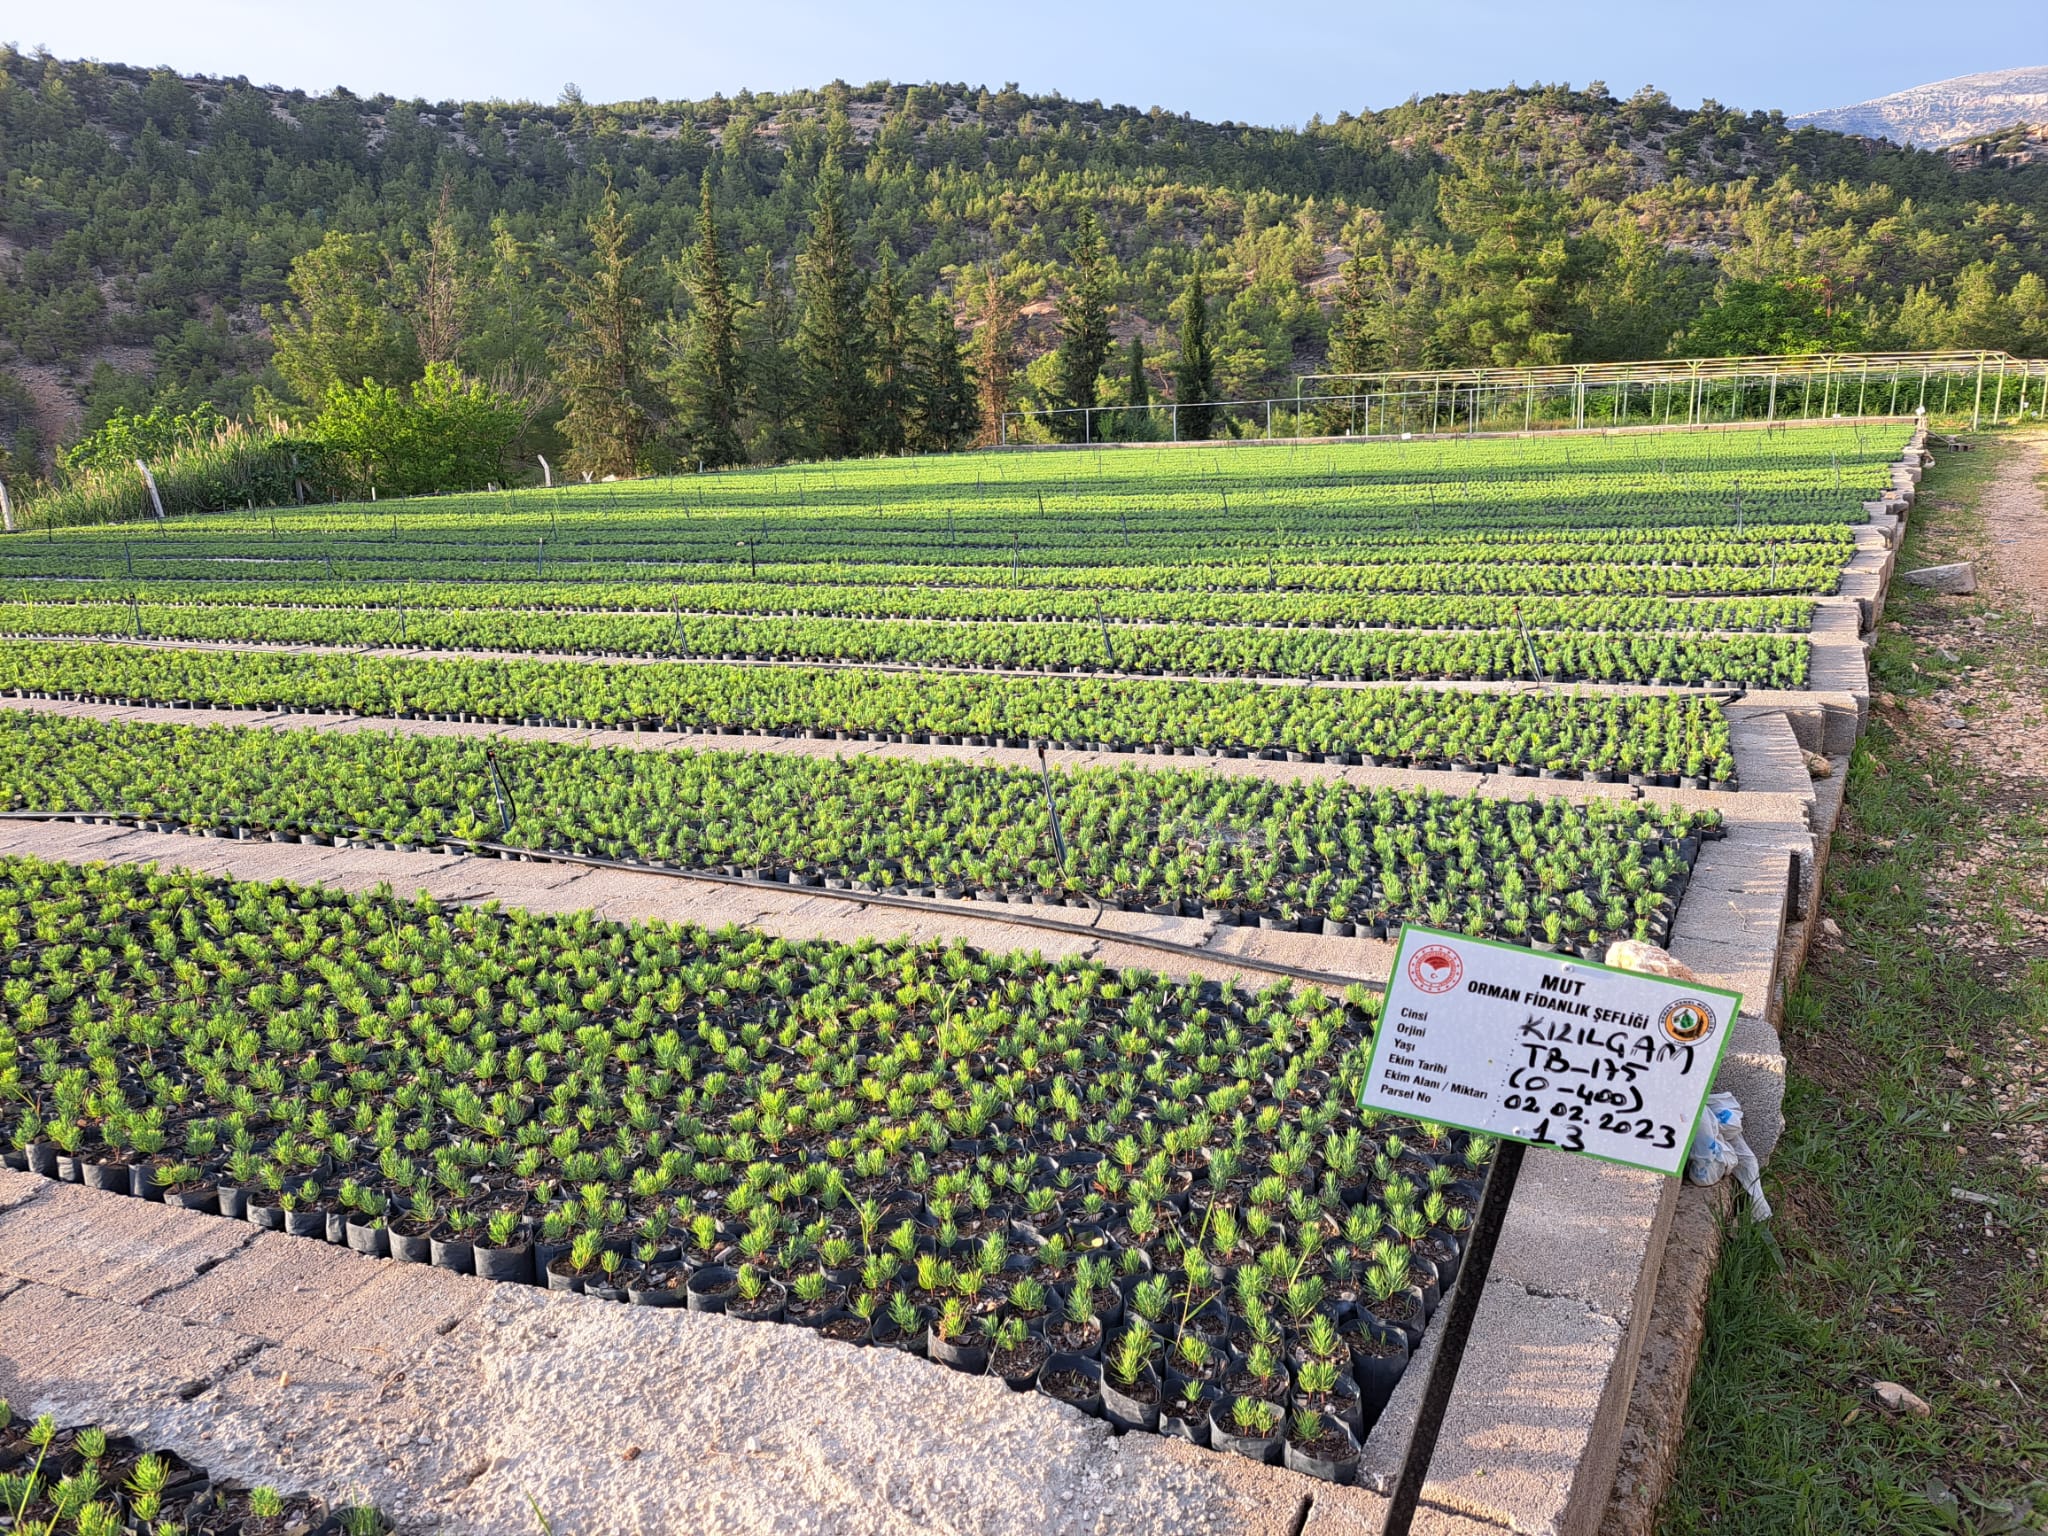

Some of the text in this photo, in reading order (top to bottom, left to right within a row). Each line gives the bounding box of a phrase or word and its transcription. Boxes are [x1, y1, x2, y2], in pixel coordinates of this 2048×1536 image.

[1540, 974, 1586, 996] MUT
[1400, 1007, 1428, 1021] Cinsi
[1467, 980, 1650, 1030] ORMAN FİDANLIK ŞEFLİĞİ
[1397, 1023, 1426, 1037] Orjini
[1394, 1038, 1415, 1052] Yaşı
[1388, 1053, 1448, 1074] Ekim Tarihi
[1380, 1084, 1431, 1103] Parsel No
[1384, 1069, 1410, 1082] Ekim
[1413, 1075, 1440, 1089] Alanı
[1450, 1083, 1488, 1099] Miktarı
